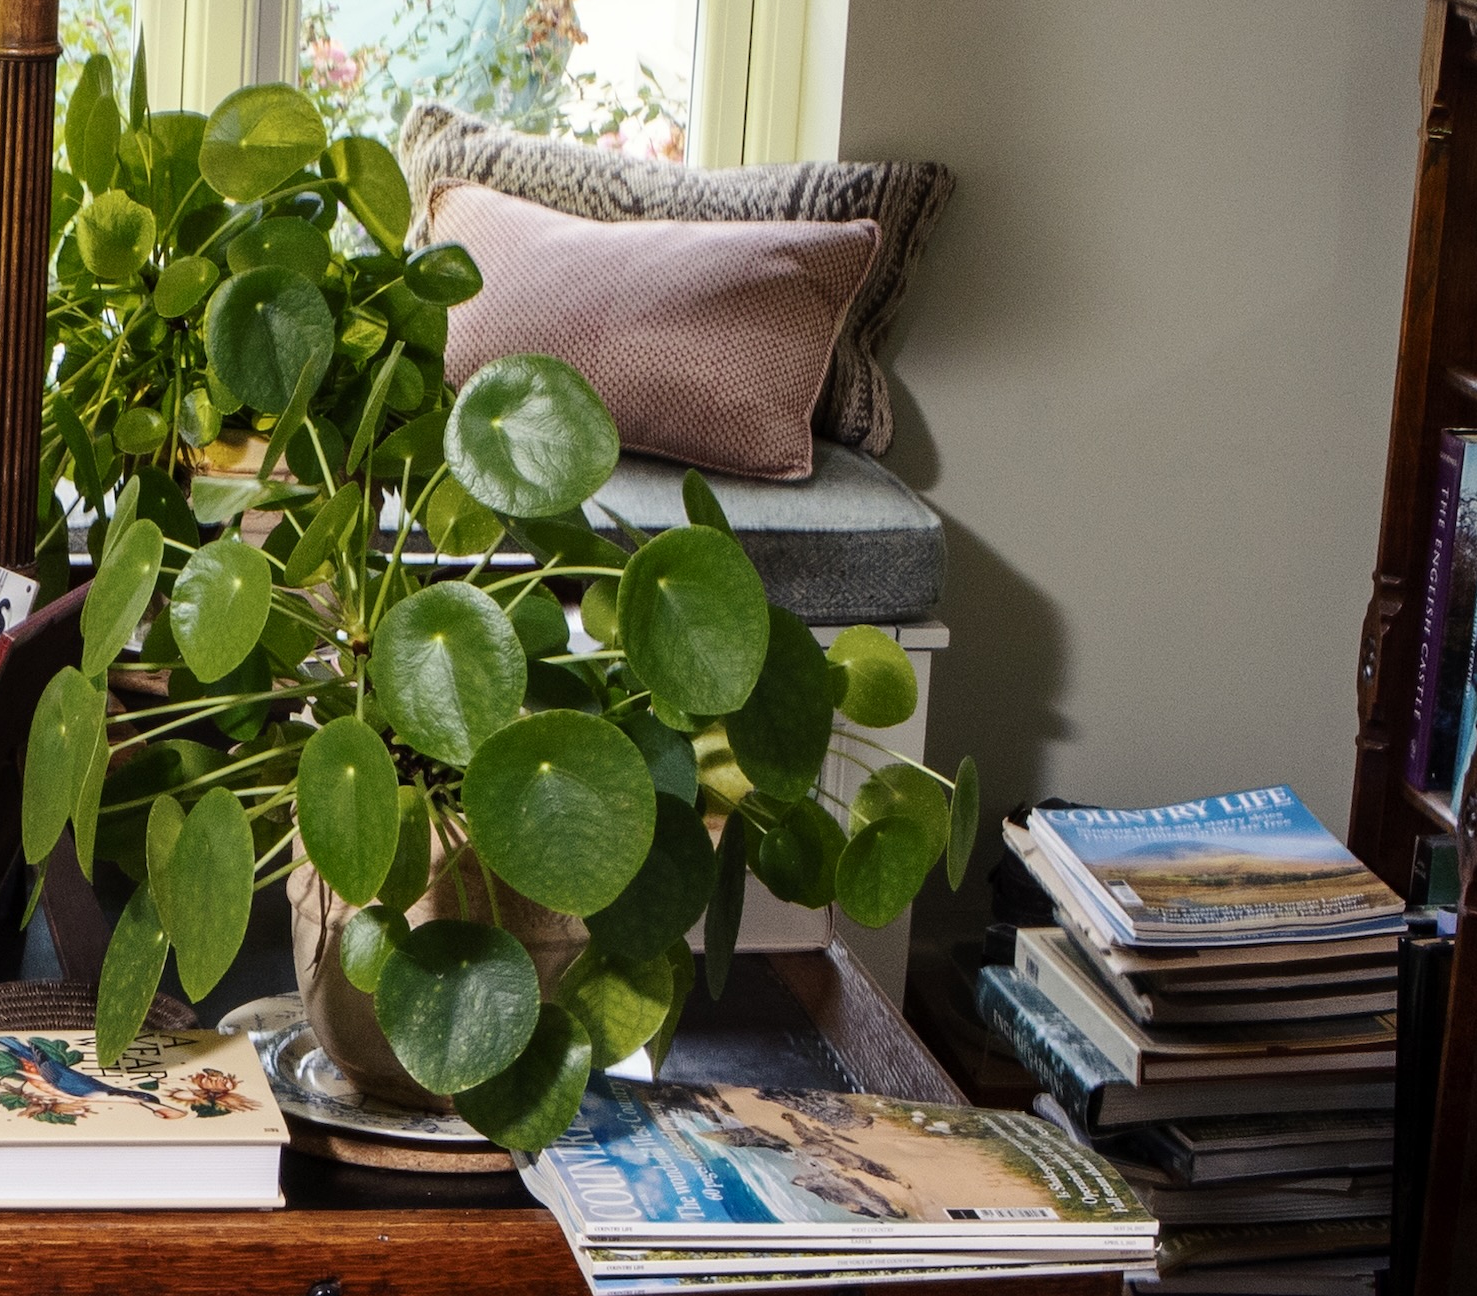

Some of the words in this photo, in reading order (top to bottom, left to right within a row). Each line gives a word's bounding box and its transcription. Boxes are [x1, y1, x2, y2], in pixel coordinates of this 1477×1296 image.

[1435, 486, 1450, 528] THE
[1420, 537, 1444, 635] ENGLISH
[1410, 641, 1431, 721] CASTLE
[1462, 649, 1476, 699] CENTURY
[1045, 798, 1211, 830] COUNTRY
[1219, 784, 1293, 815] LIFE
[162, 1035, 199, 1050] A
[676, 1195, 705, 1218] The
